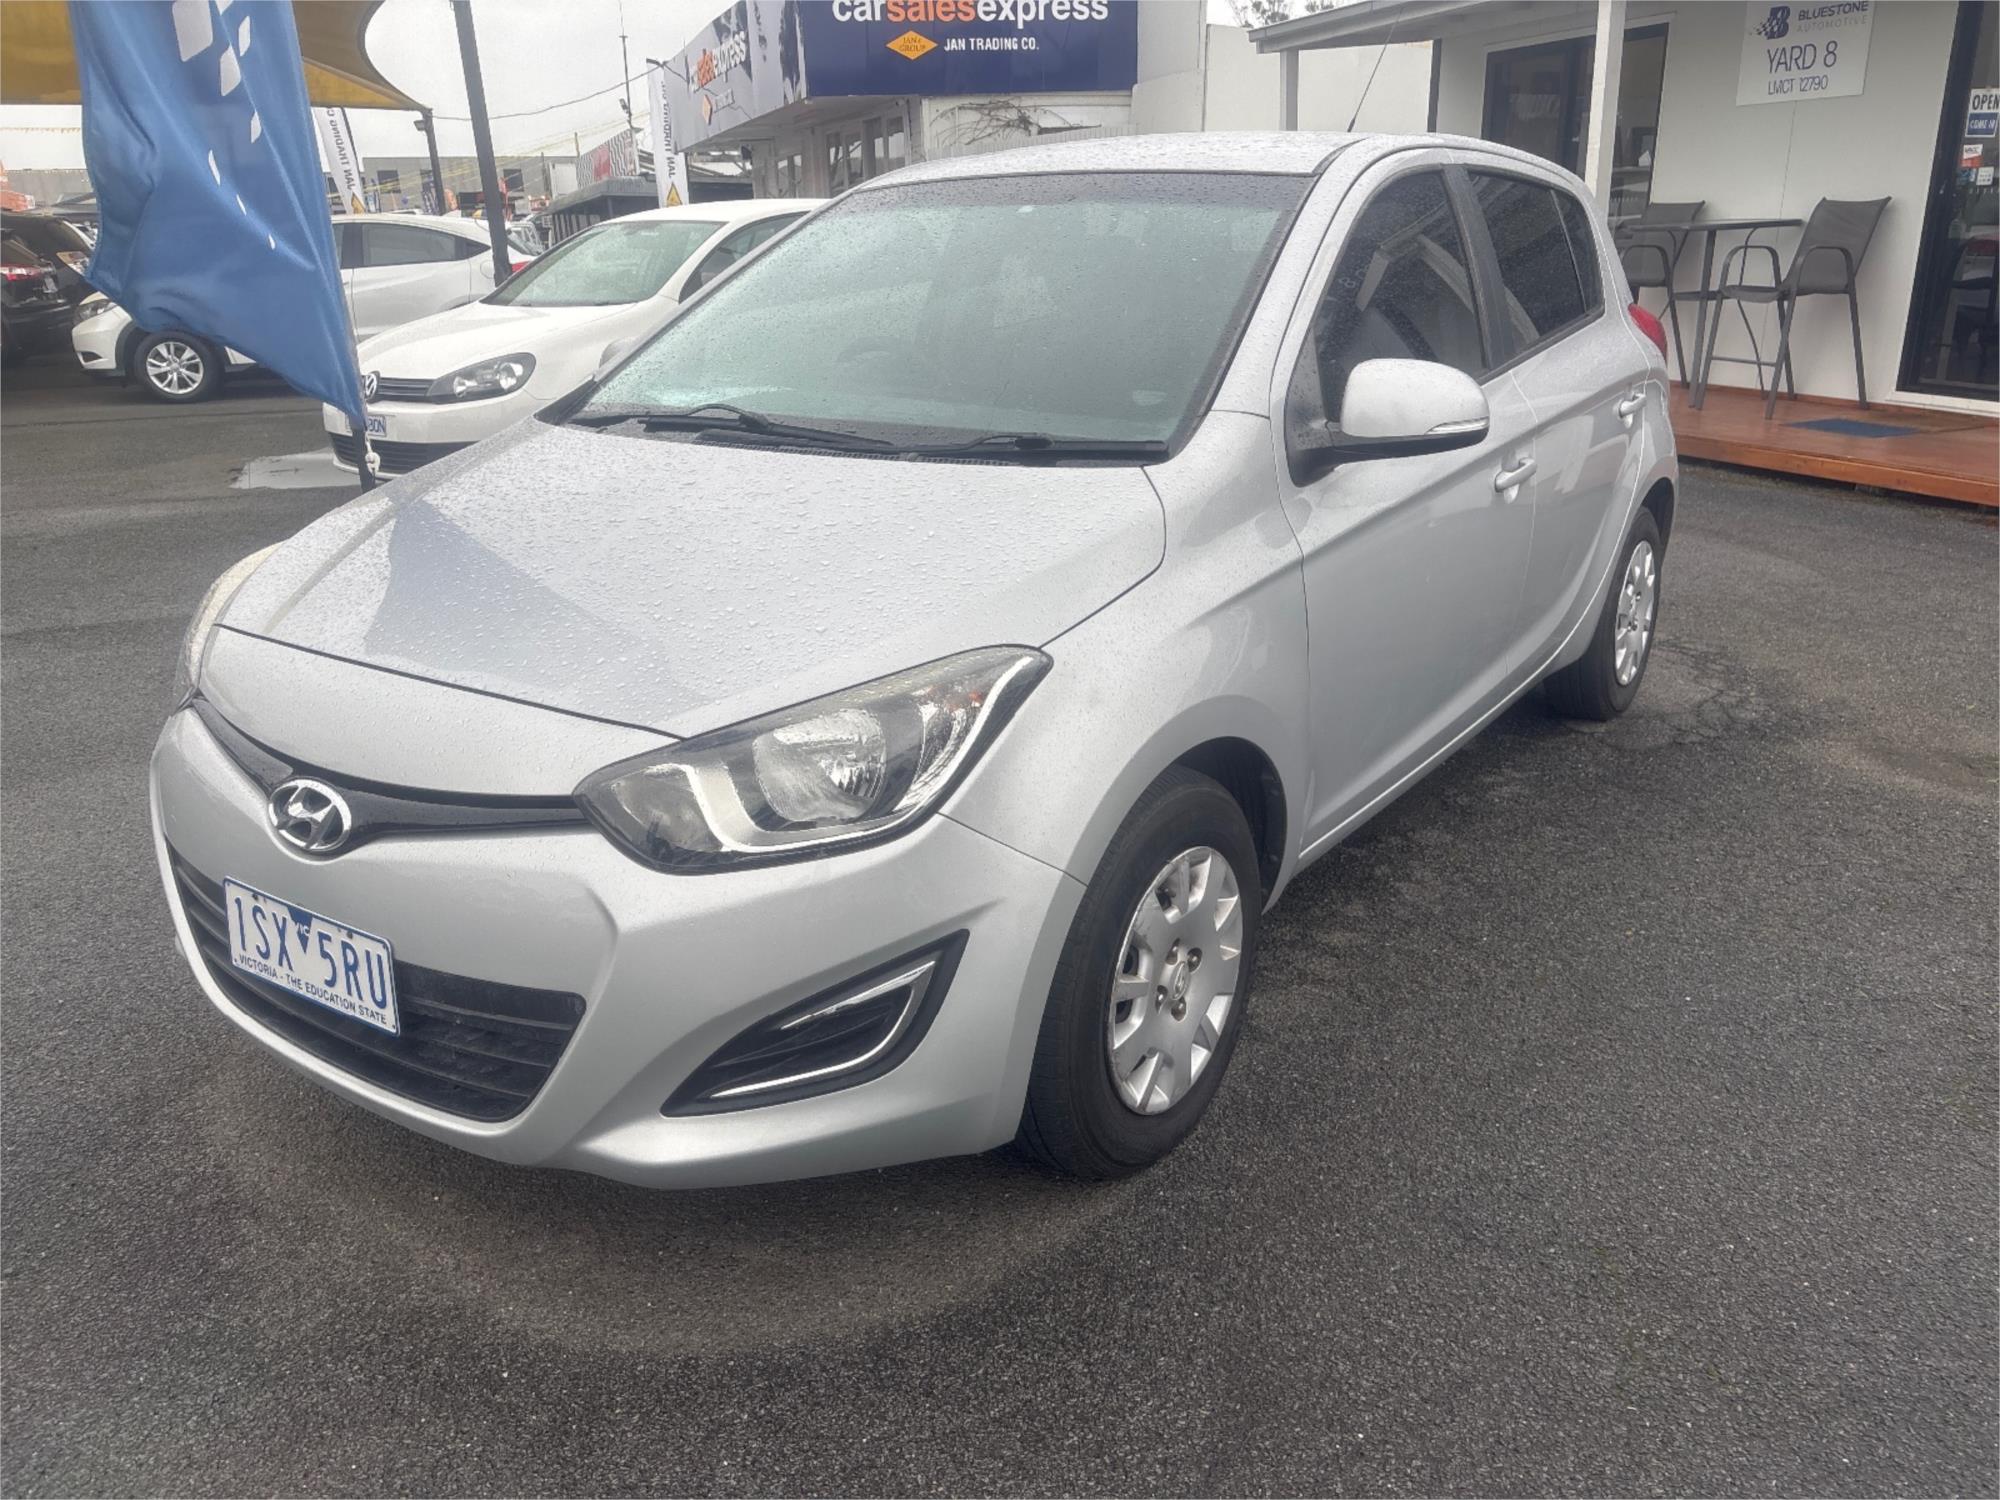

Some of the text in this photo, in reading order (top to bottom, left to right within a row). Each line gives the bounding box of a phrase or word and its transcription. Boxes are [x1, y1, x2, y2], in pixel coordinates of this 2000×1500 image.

[1797, 1, 1869, 21] BLUESTONE
[1796, 14, 1867, 33] AUTOMOTIVE
[944, 37, 1040, 51] JAN TRADING CO.
[1767, 40, 1838, 74] YARD 8
[1768, 74, 1829, 96] LMCT 12790
[1972, 94, 1999, 110] OPEN
[234, 897, 387, 1009] 1SX 5RU
[239, 953, 277, 980] VICTORIA
[286, 973, 303, 991] THE
[305, 982, 356, 1014] EDUCATION
[358, 1006, 387, 1025] STATE
